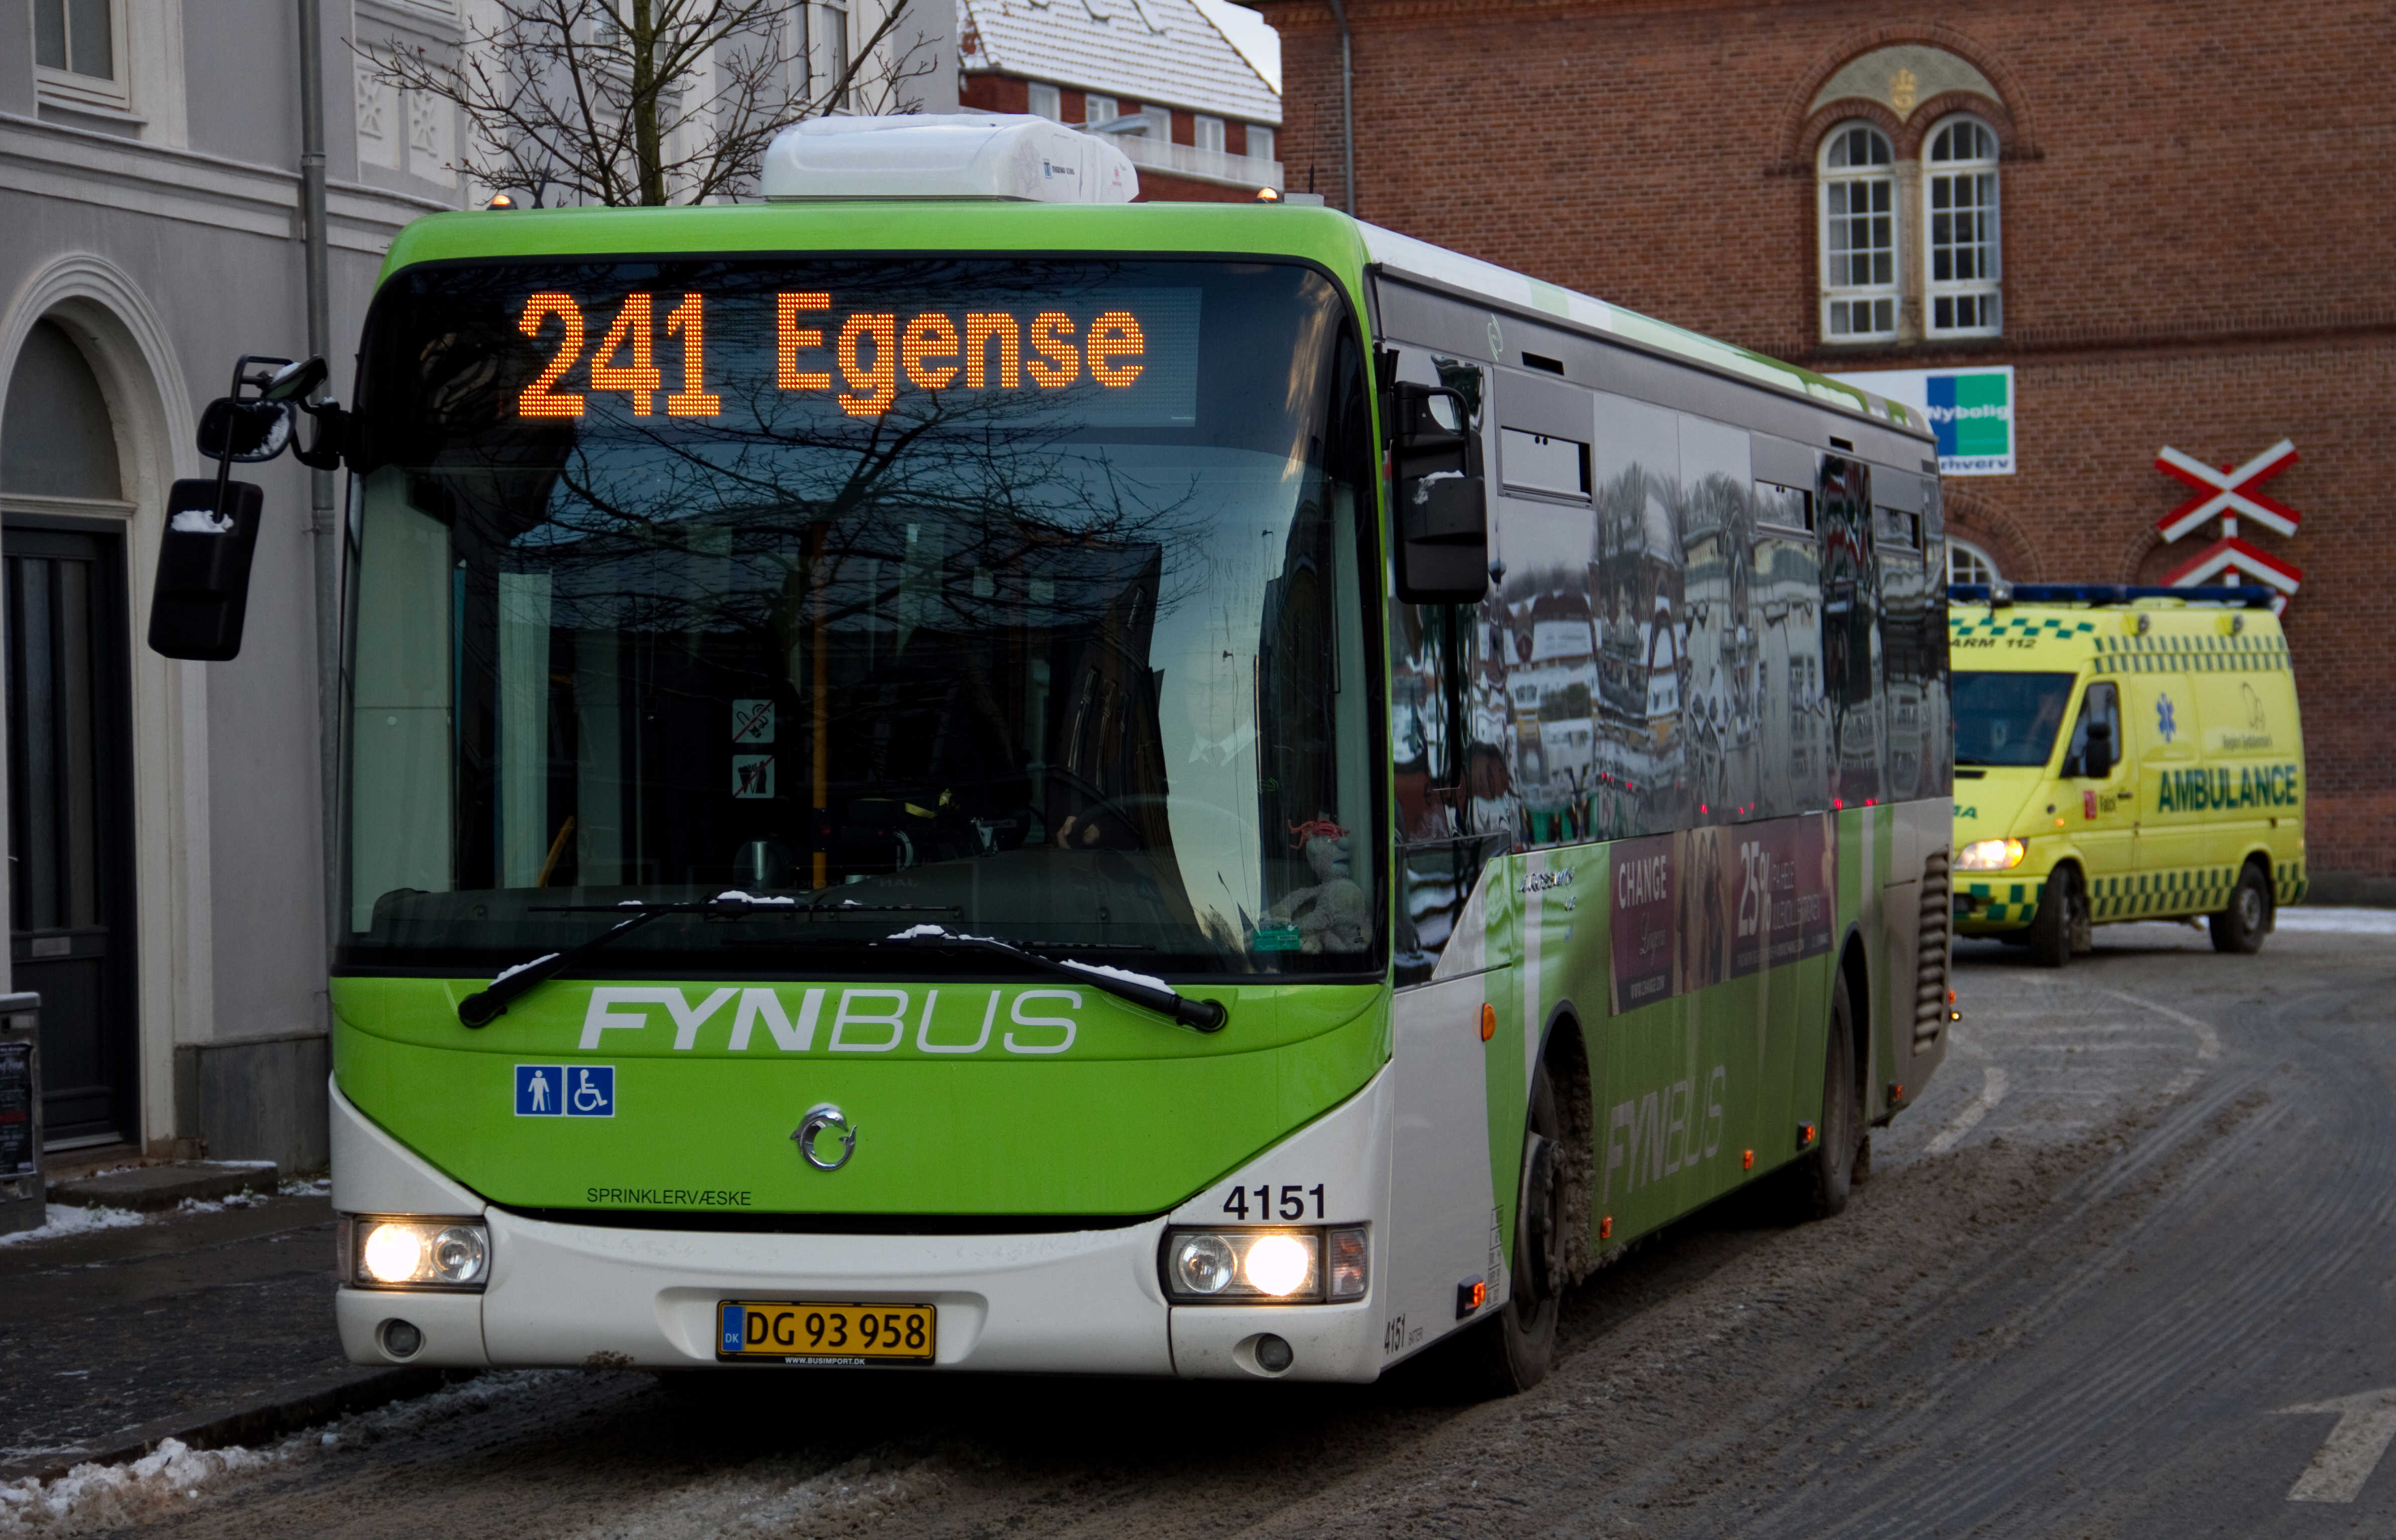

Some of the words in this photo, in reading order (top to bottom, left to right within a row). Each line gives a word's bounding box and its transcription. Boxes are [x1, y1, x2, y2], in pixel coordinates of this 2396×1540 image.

[519, 293, 719, 416] 241
[778, 293, 1144, 415] Egense
[1928, 404, 2008, 423] Nybolig
[1950, 638, 1996, 648] ARM
[2006, 638, 2037, 649] 112
[2159, 764, 2298, 813] AMBULANCE
[1618, 855, 1667, 909] CHANGE
[1738, 840, 1772, 938] 25%
[578, 987, 1083, 1054] FYNBUS
[1602, 1065, 1726, 1205] FYNBUS
[587, 1188, 751, 1206] SPRINKLERVÆSKE
[1223, 1184, 1324, 1220] 4151
[725, 1333, 739, 1343] DK
[746, 1312, 795, 1346] DG
[805, 1313, 847, 1348] 93
[859, 1313, 926, 1349] 958
[1384, 1313, 1406, 1355] 4151
[785, 1357, 865, 1365] WWW.BUSIMPORT.DK
